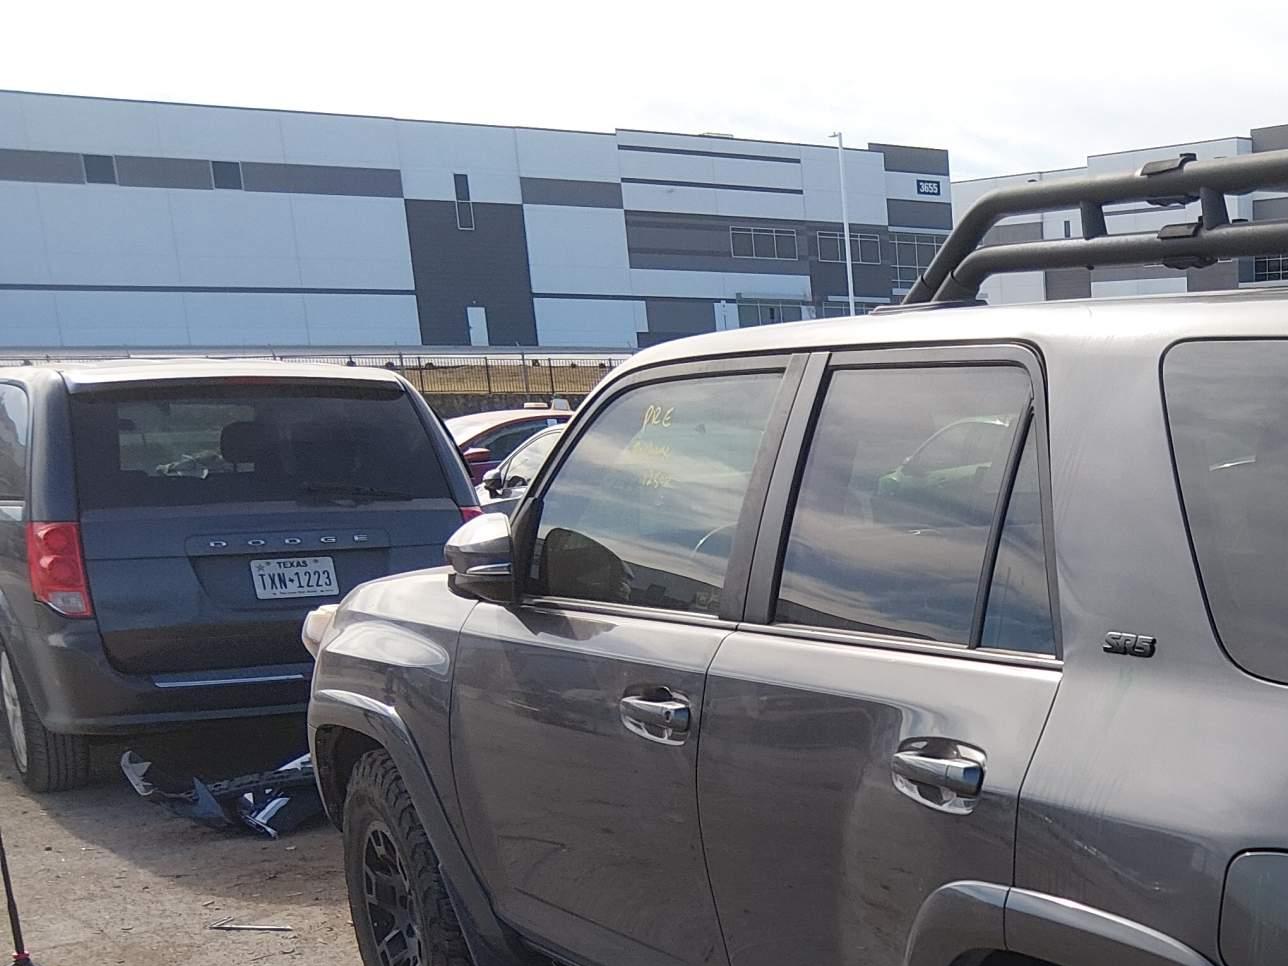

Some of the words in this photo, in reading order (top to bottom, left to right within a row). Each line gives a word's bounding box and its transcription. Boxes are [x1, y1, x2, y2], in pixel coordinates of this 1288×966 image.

[919, 182, 939, 193] 3655
[642, 404, 675, 432] PRE
[209, 534, 368, 547] DODGE
[276, 561, 308, 569] TEXAS
[258, 572, 287, 591] TXN
[294, 569, 333, 589] 1223
[1102, 631, 1157, 659] SR5
